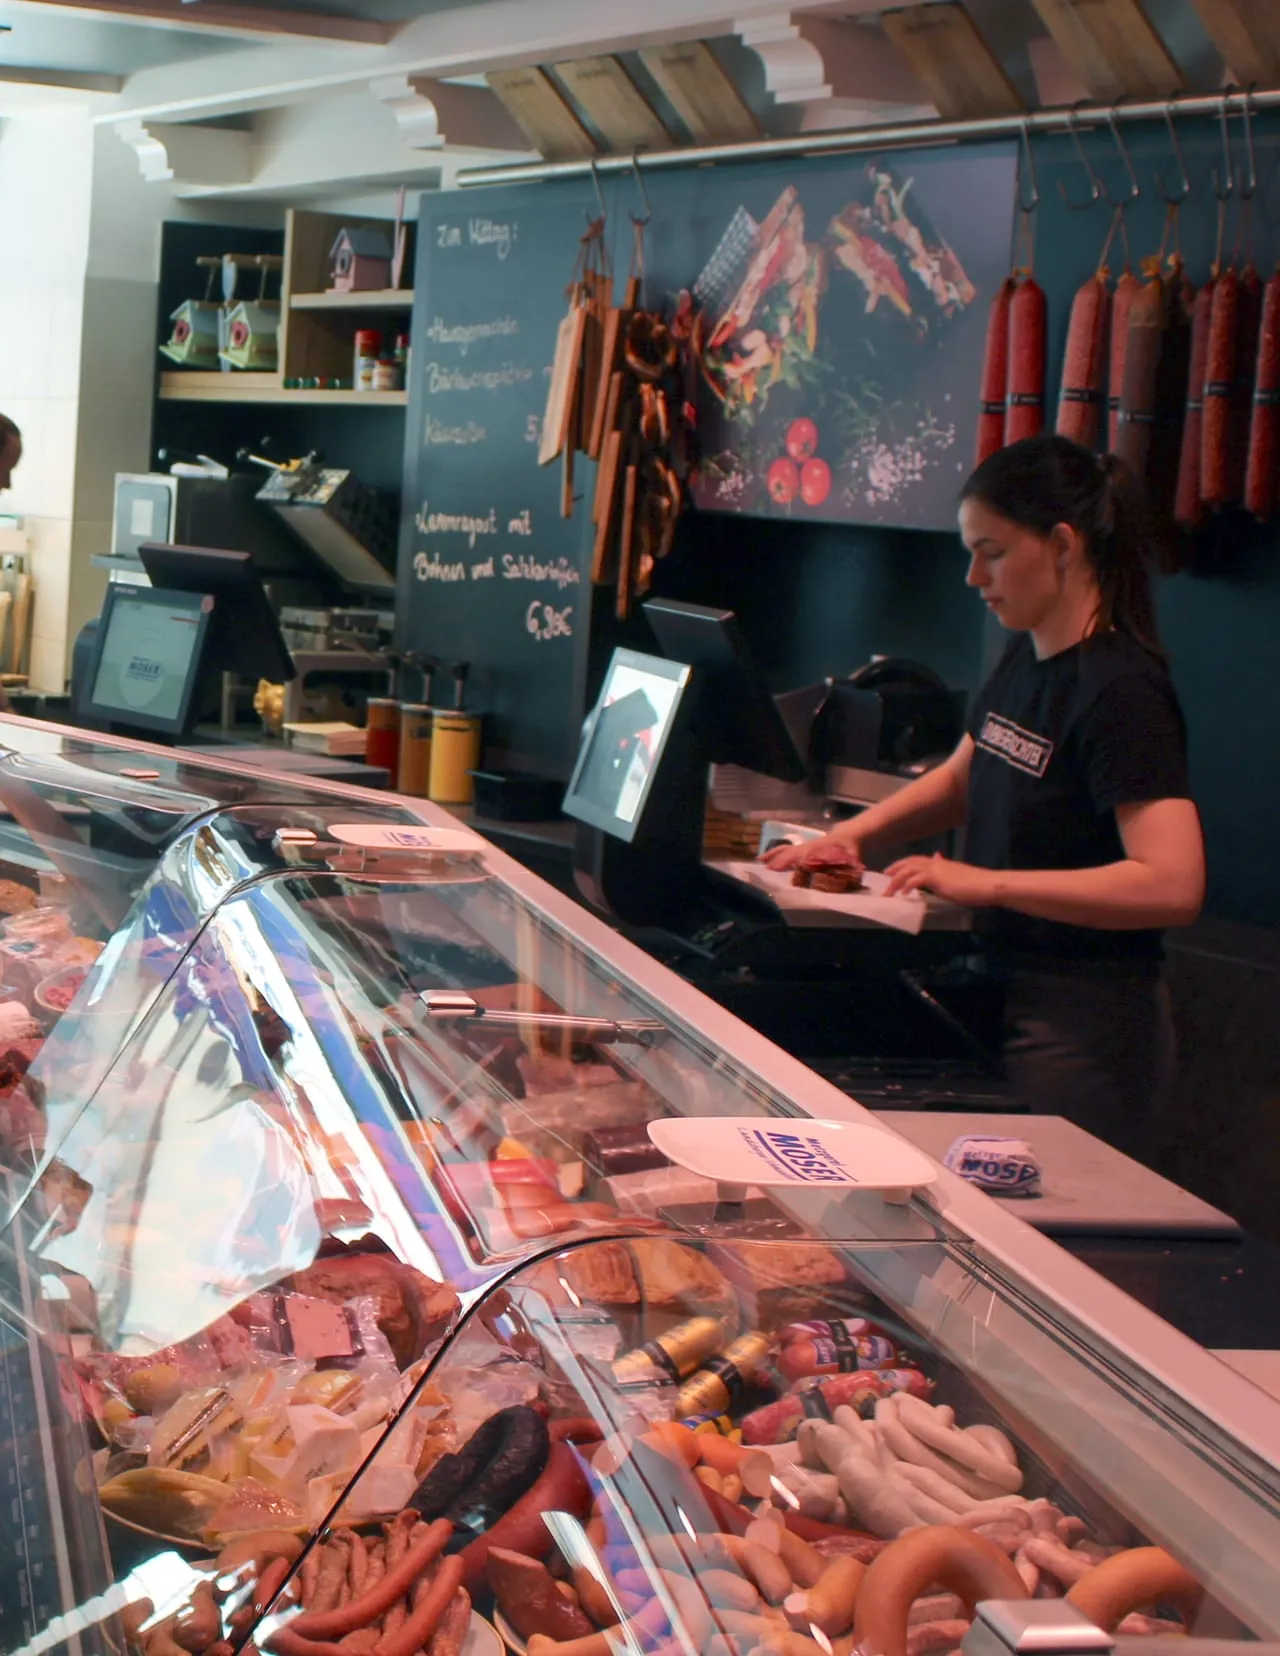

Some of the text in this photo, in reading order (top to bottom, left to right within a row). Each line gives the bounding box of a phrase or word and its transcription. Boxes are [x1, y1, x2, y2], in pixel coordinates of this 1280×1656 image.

[508, 509, 532, 536] mit
[413, 551, 466, 582] Bohnen
[471, 556, 495, 581] und
[766, 1131, 847, 1181] MOSER
